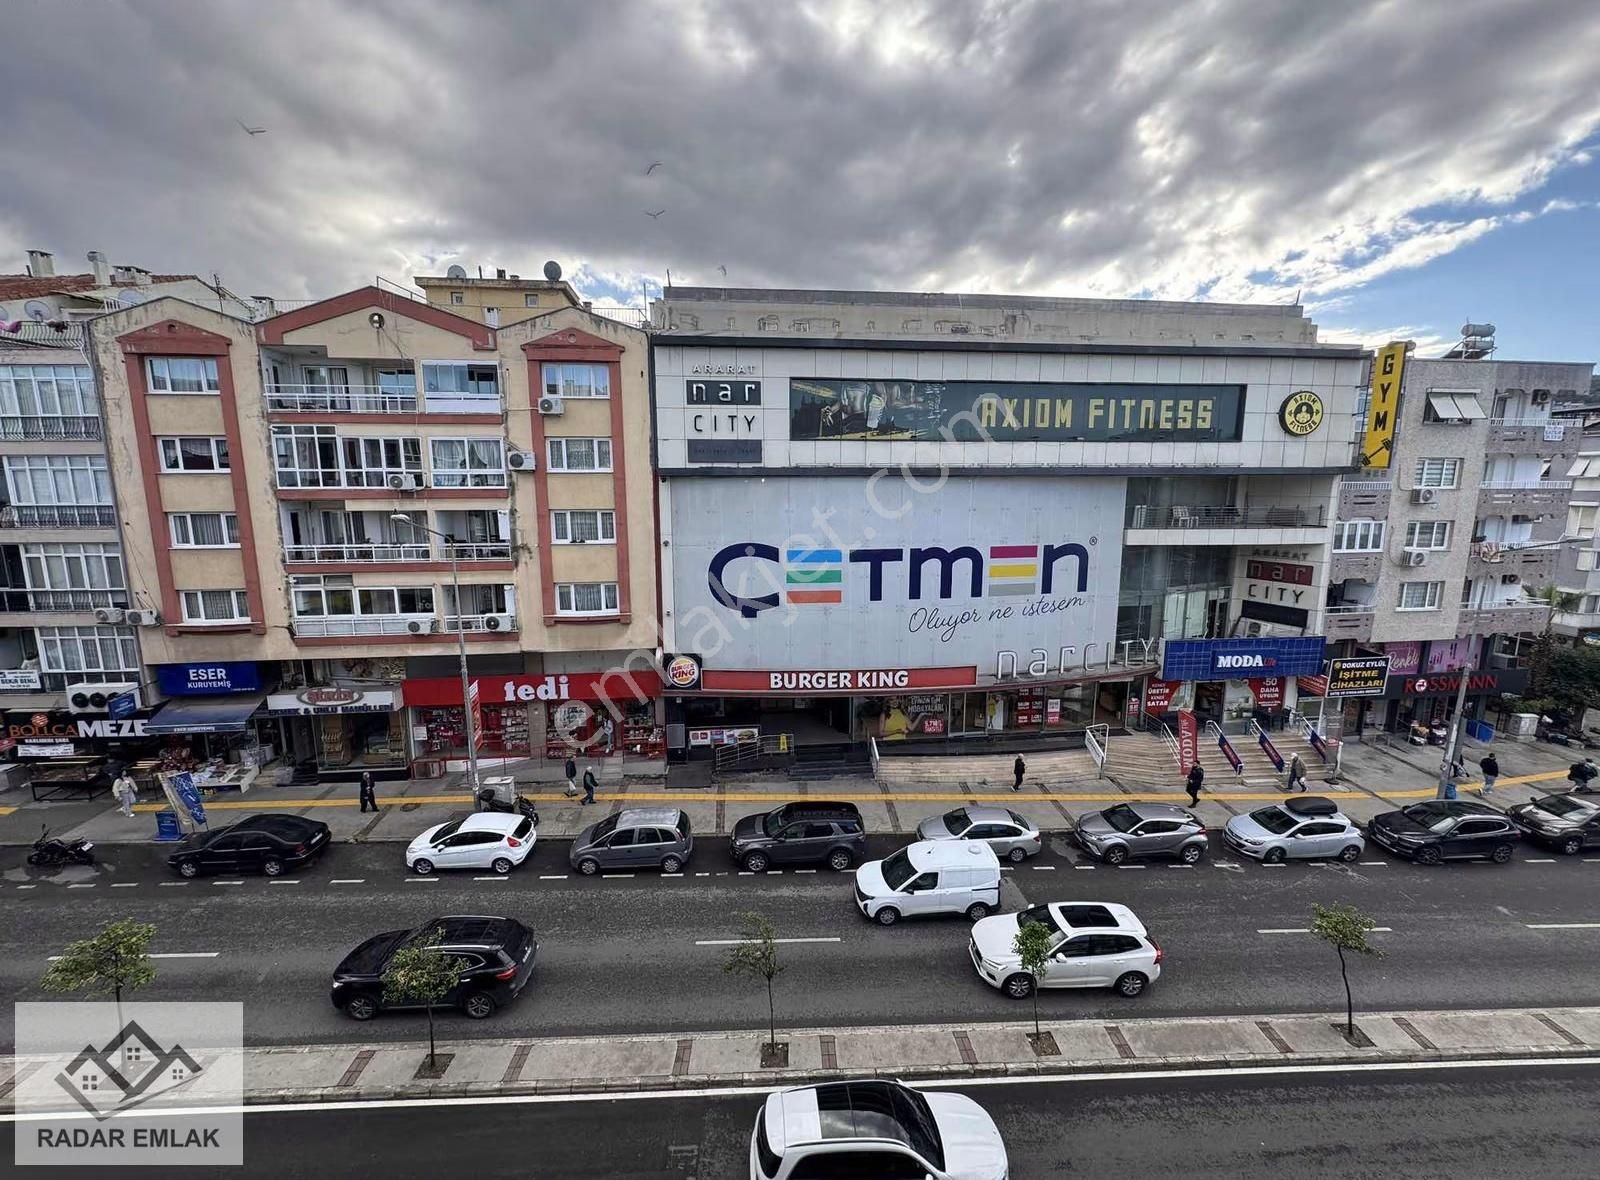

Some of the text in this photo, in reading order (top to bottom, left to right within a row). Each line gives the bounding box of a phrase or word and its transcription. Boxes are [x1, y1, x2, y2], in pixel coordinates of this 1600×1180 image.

[693, 364, 756, 375] ARARAT
[692, 383, 756, 402] nar
[1374, 353, 1395, 432] GYM
[982, 398, 1073, 429] AXIOM
[1088, 398, 1213, 430] FITNESS
[693, 414, 756, 433] CITY
[1248, 583, 1305, 604] CITY
[908, 596, 1087, 643] Oluyor ne istesem
[671, 663, 696, 672] BURGER
[1341, 659, 1387, 669] DOKUZ EYLÜL
[188, 668, 227, 681] ESER
[672, 669, 696, 680] KING
[769, 670, 909, 689] BURGER KING
[1339, 669, 1379, 679] İŞİTME
[187, 680, 232, 689] KURUYEMİŞ
[1330, 679, 1384, 689] CİHAZLARI
[77, 719, 149, 738] MEZE
